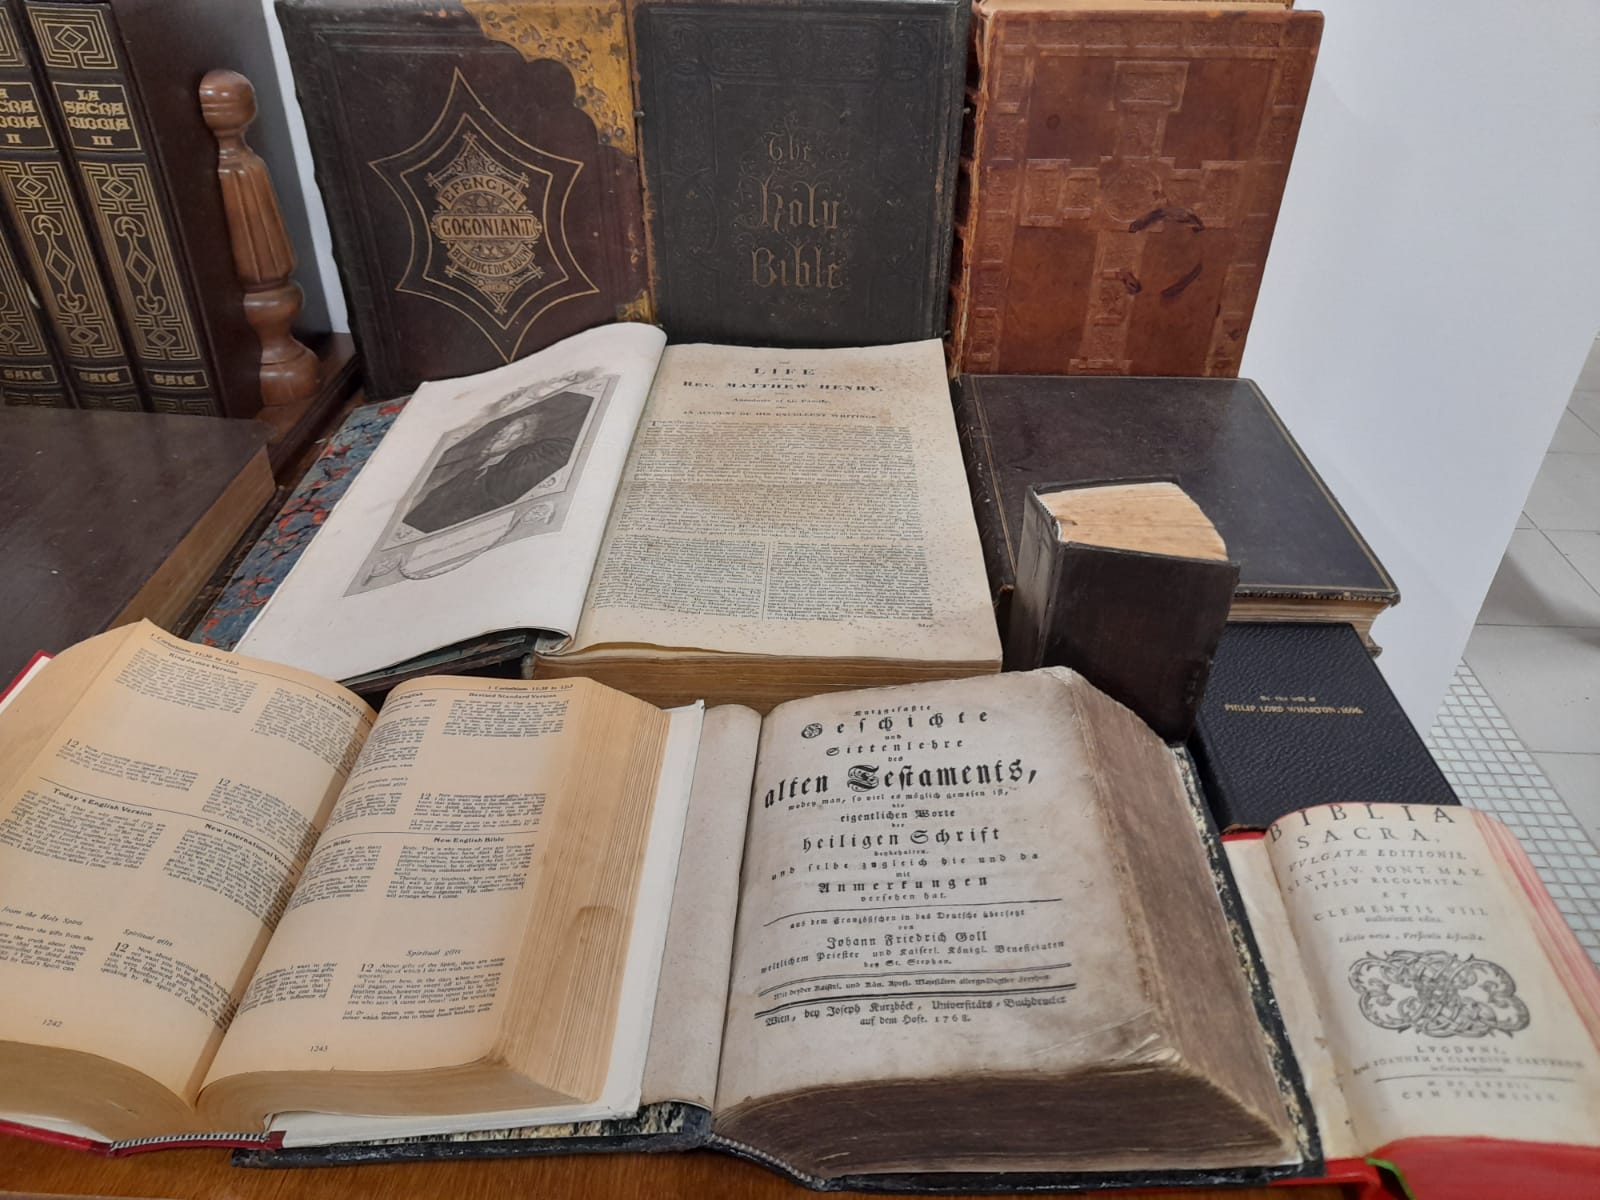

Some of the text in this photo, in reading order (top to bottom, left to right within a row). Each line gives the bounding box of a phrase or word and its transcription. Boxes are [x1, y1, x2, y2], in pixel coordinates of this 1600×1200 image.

[76, 89, 100, 101] LA
[63, 101, 126, 115] SACRA
[6, 133, 22, 144] II
[91, 135, 114, 146] III
[751, 170, 840, 234] Holy
[751, 240, 845, 289] Bible
[765, 775, 829, 809] alten
[88, 798, 119, 811] English
[122, 806, 152, 817] Version
[840, 809, 956, 824] eigentlichen Worte
[205, 823, 222, 833] New
[1268, 804, 1456, 844] BIBLIA
[453, 836, 483, 844] English
[802, 826, 1001, 853] heiligen Schrift
[114, 942, 129, 953] 12
[826, 937, 876, 950] Johann
[884, 931, 946, 946] Friedrich
[361, 963, 374, 972] 12
